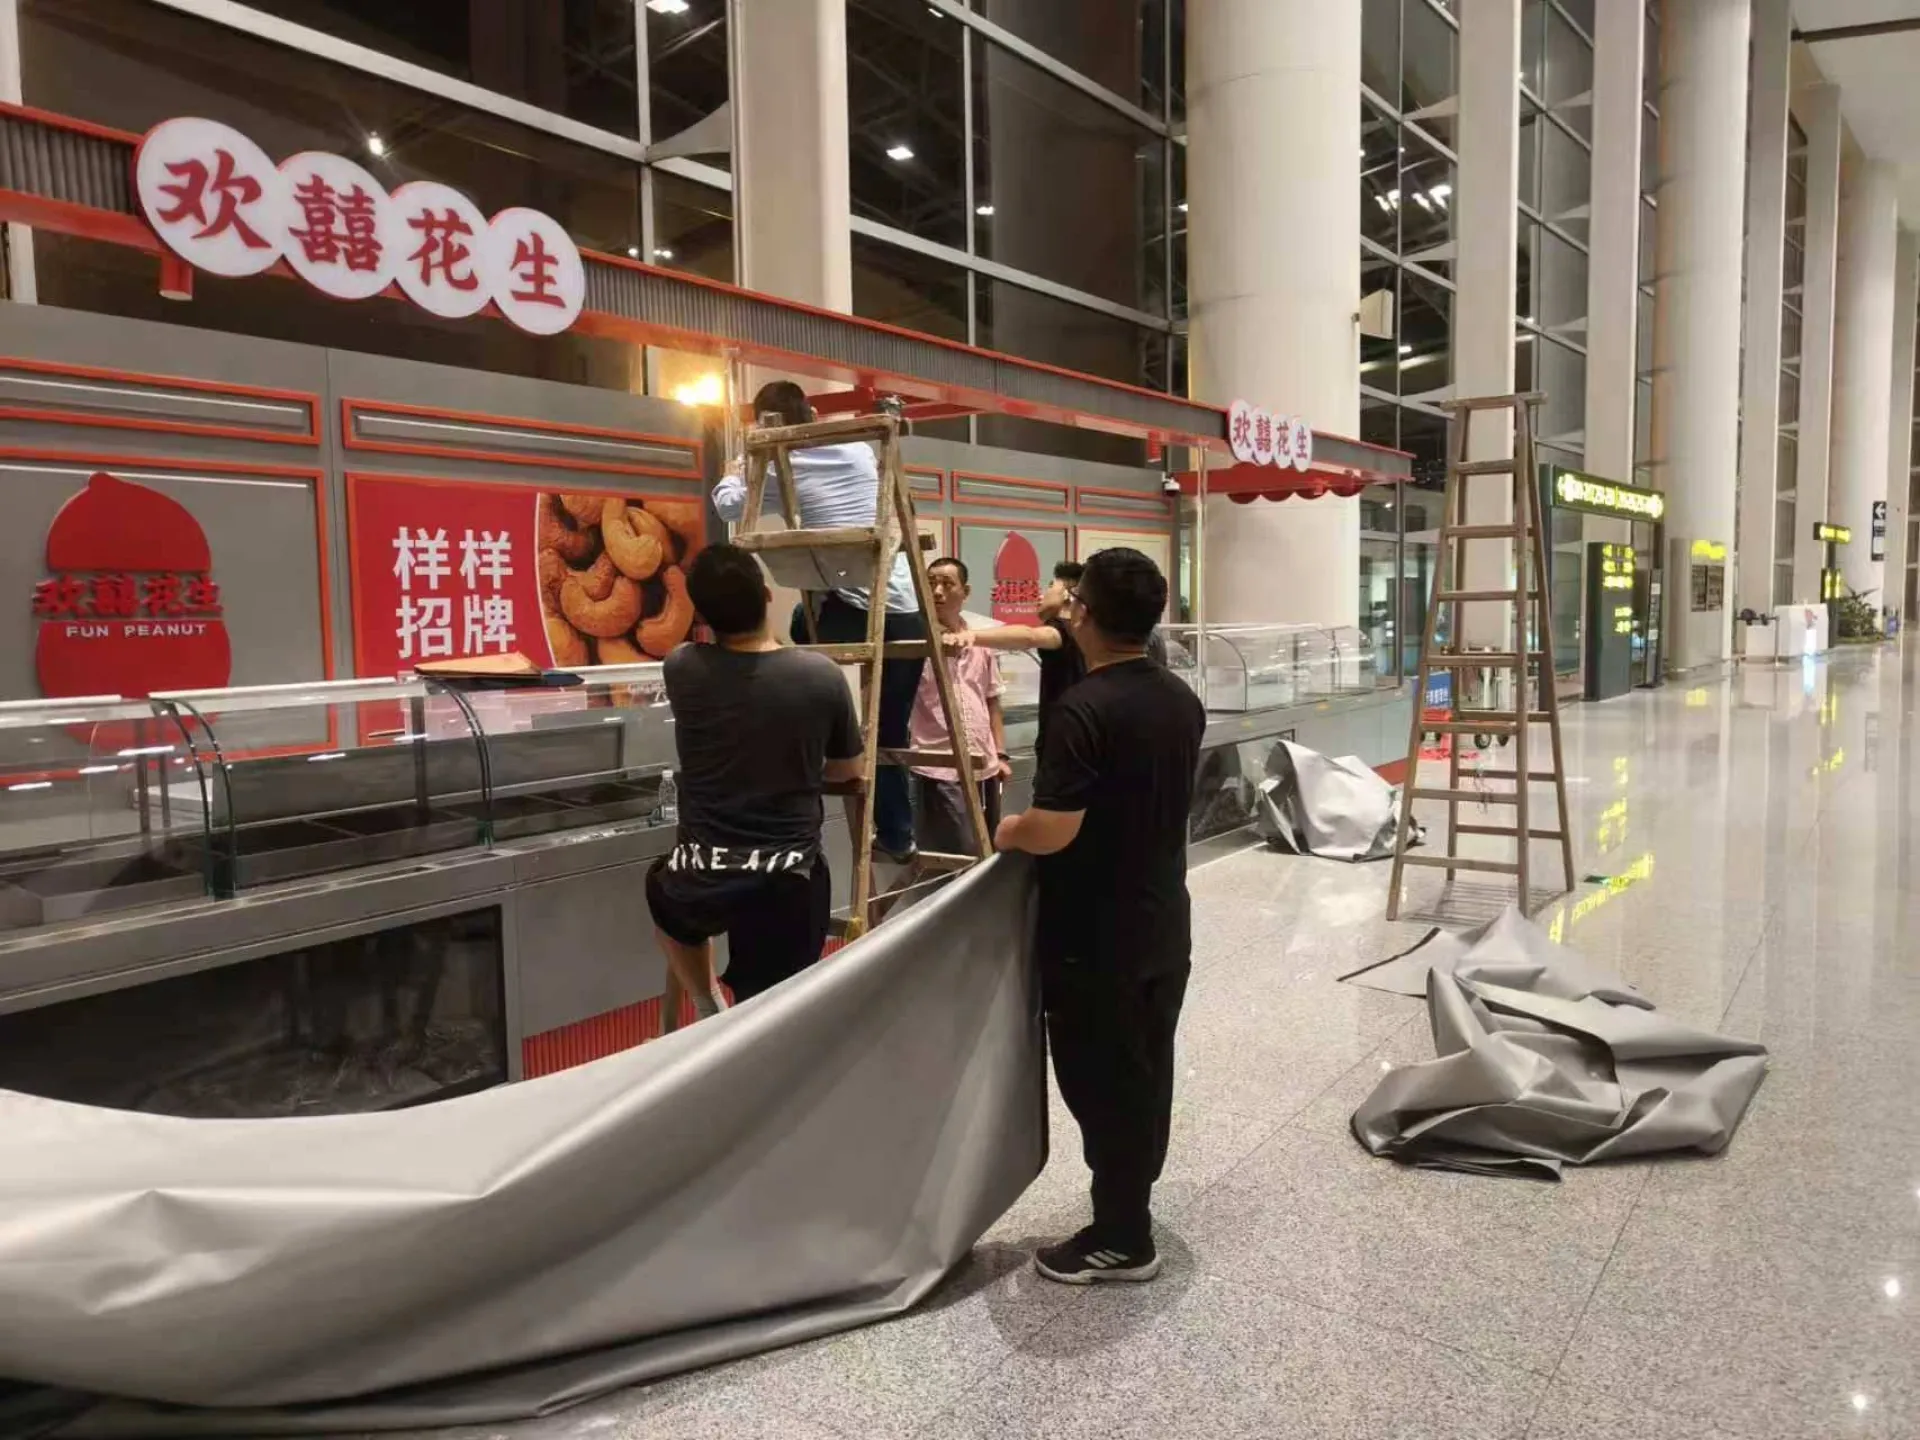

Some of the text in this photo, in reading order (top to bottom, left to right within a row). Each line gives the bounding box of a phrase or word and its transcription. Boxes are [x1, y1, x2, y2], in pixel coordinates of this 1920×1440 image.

[156, 149, 566, 309] 欢囍花生
[392, 526, 513, 590] 样样
[66, 624, 206, 638] FUN PEANUT
[396, 594, 516, 659] 招牌
